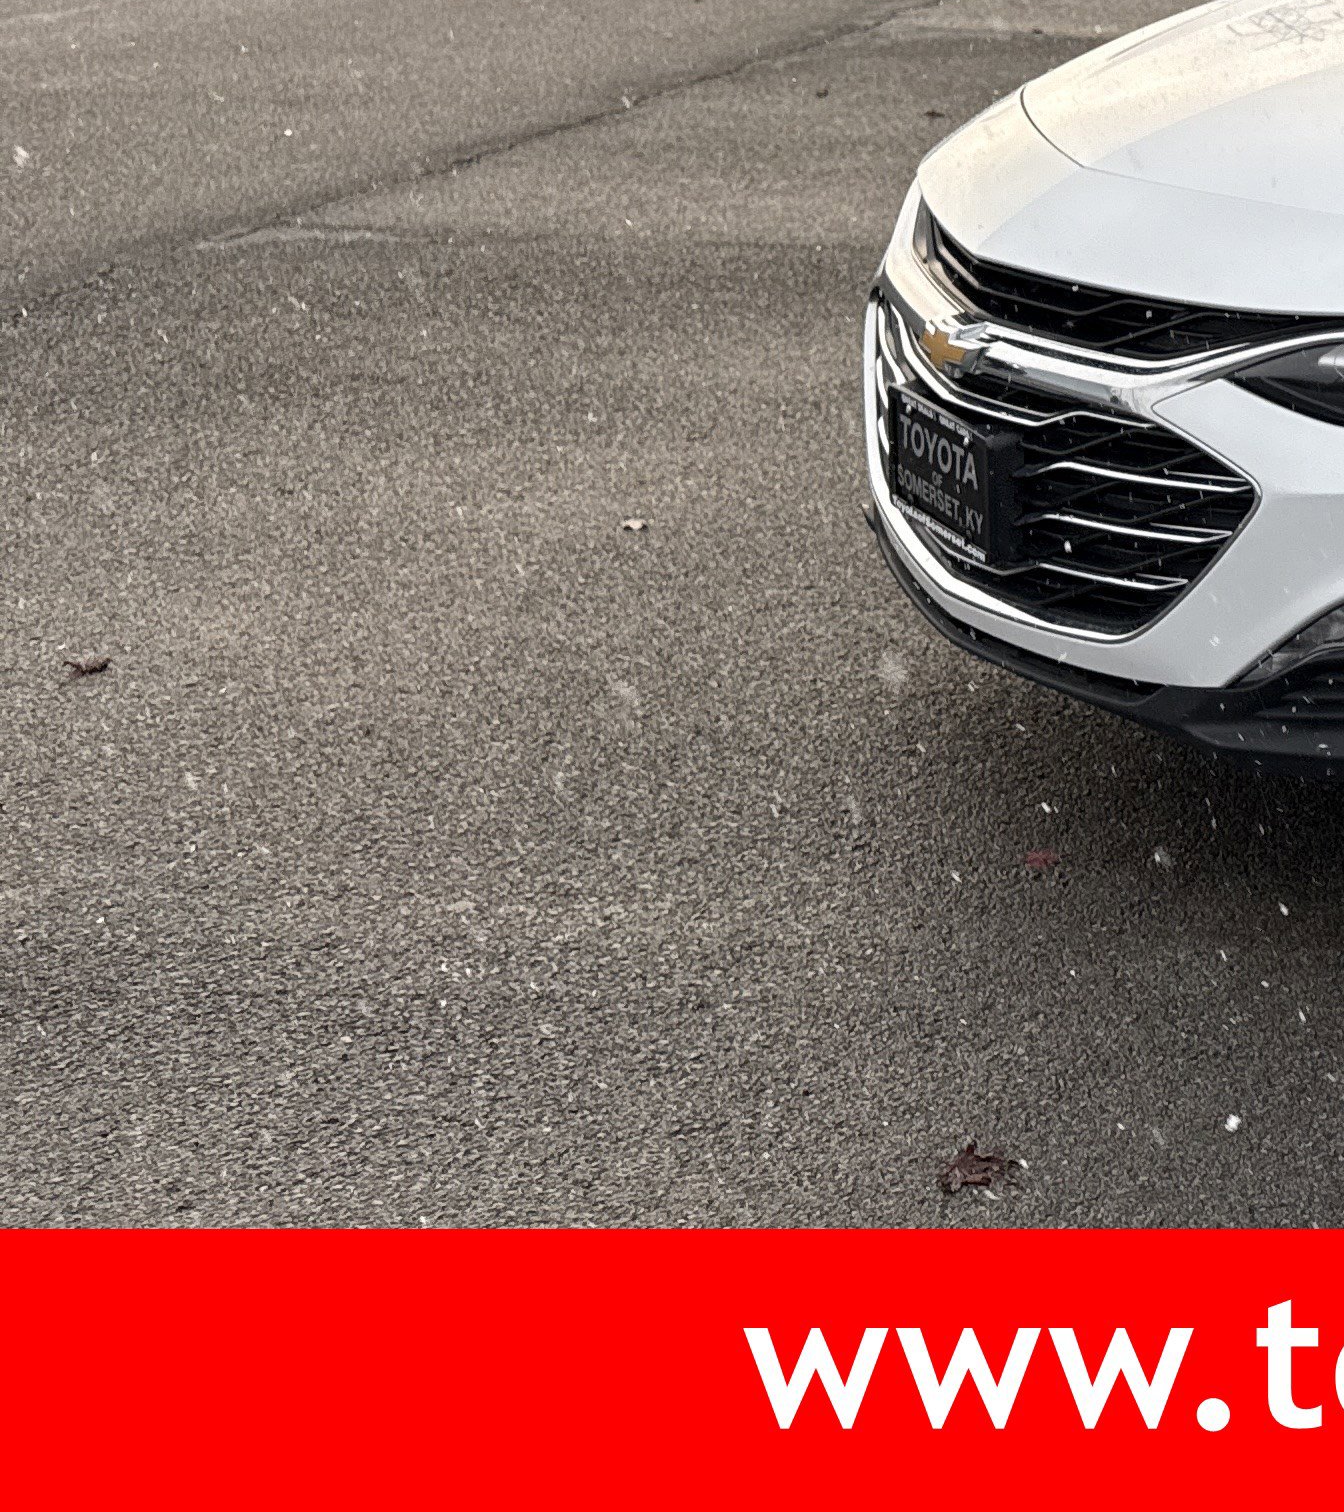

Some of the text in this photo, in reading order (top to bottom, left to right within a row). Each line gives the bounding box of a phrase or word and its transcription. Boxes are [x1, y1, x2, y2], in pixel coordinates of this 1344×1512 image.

[900, 413, 978, 490] TOYOTA
[931, 471, 943, 487] OF
[966, 505, 983, 534] KY
